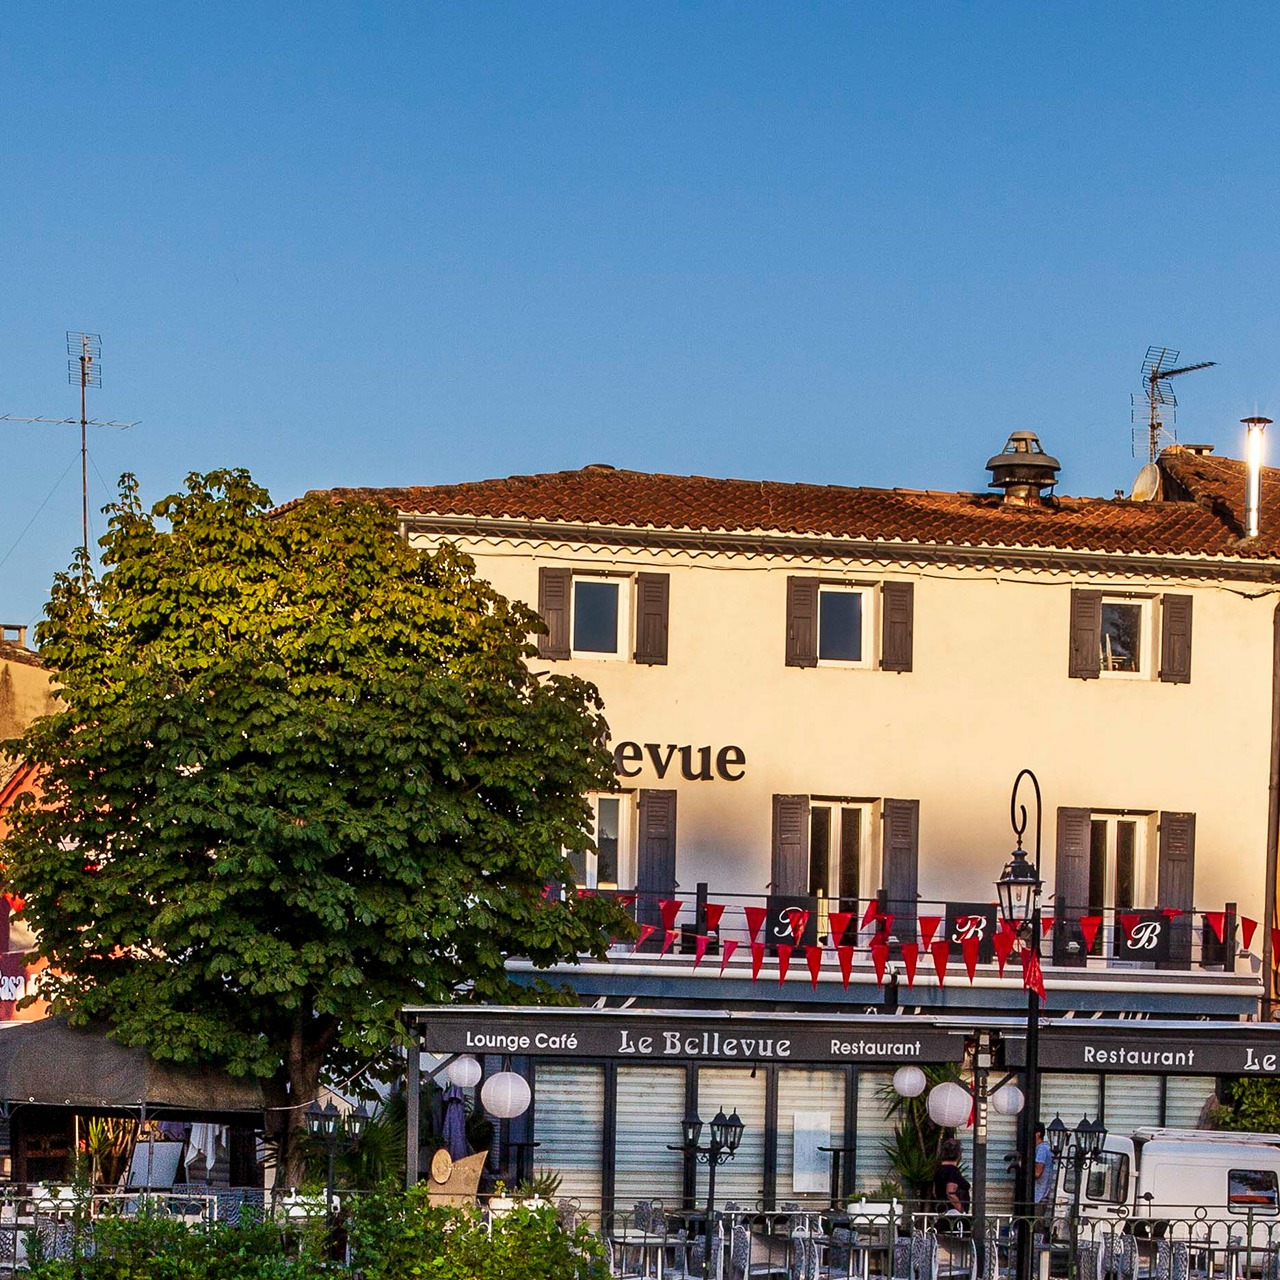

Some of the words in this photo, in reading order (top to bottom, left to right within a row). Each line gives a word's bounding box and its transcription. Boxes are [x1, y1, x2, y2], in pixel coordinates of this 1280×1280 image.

[1127, 921, 1161, 949] B
[466, 1031, 530, 1051] Lounge
[535, 1033, 578, 1049] Café
[617, 1030, 653, 1054] Le
[662, 1031, 791, 1057] Bellevue
[830, 1039, 921, 1056] Restaurant
[1084, 1046, 1195, 1066] Restaurant
[1243, 1048, 1277, 1071] Le
